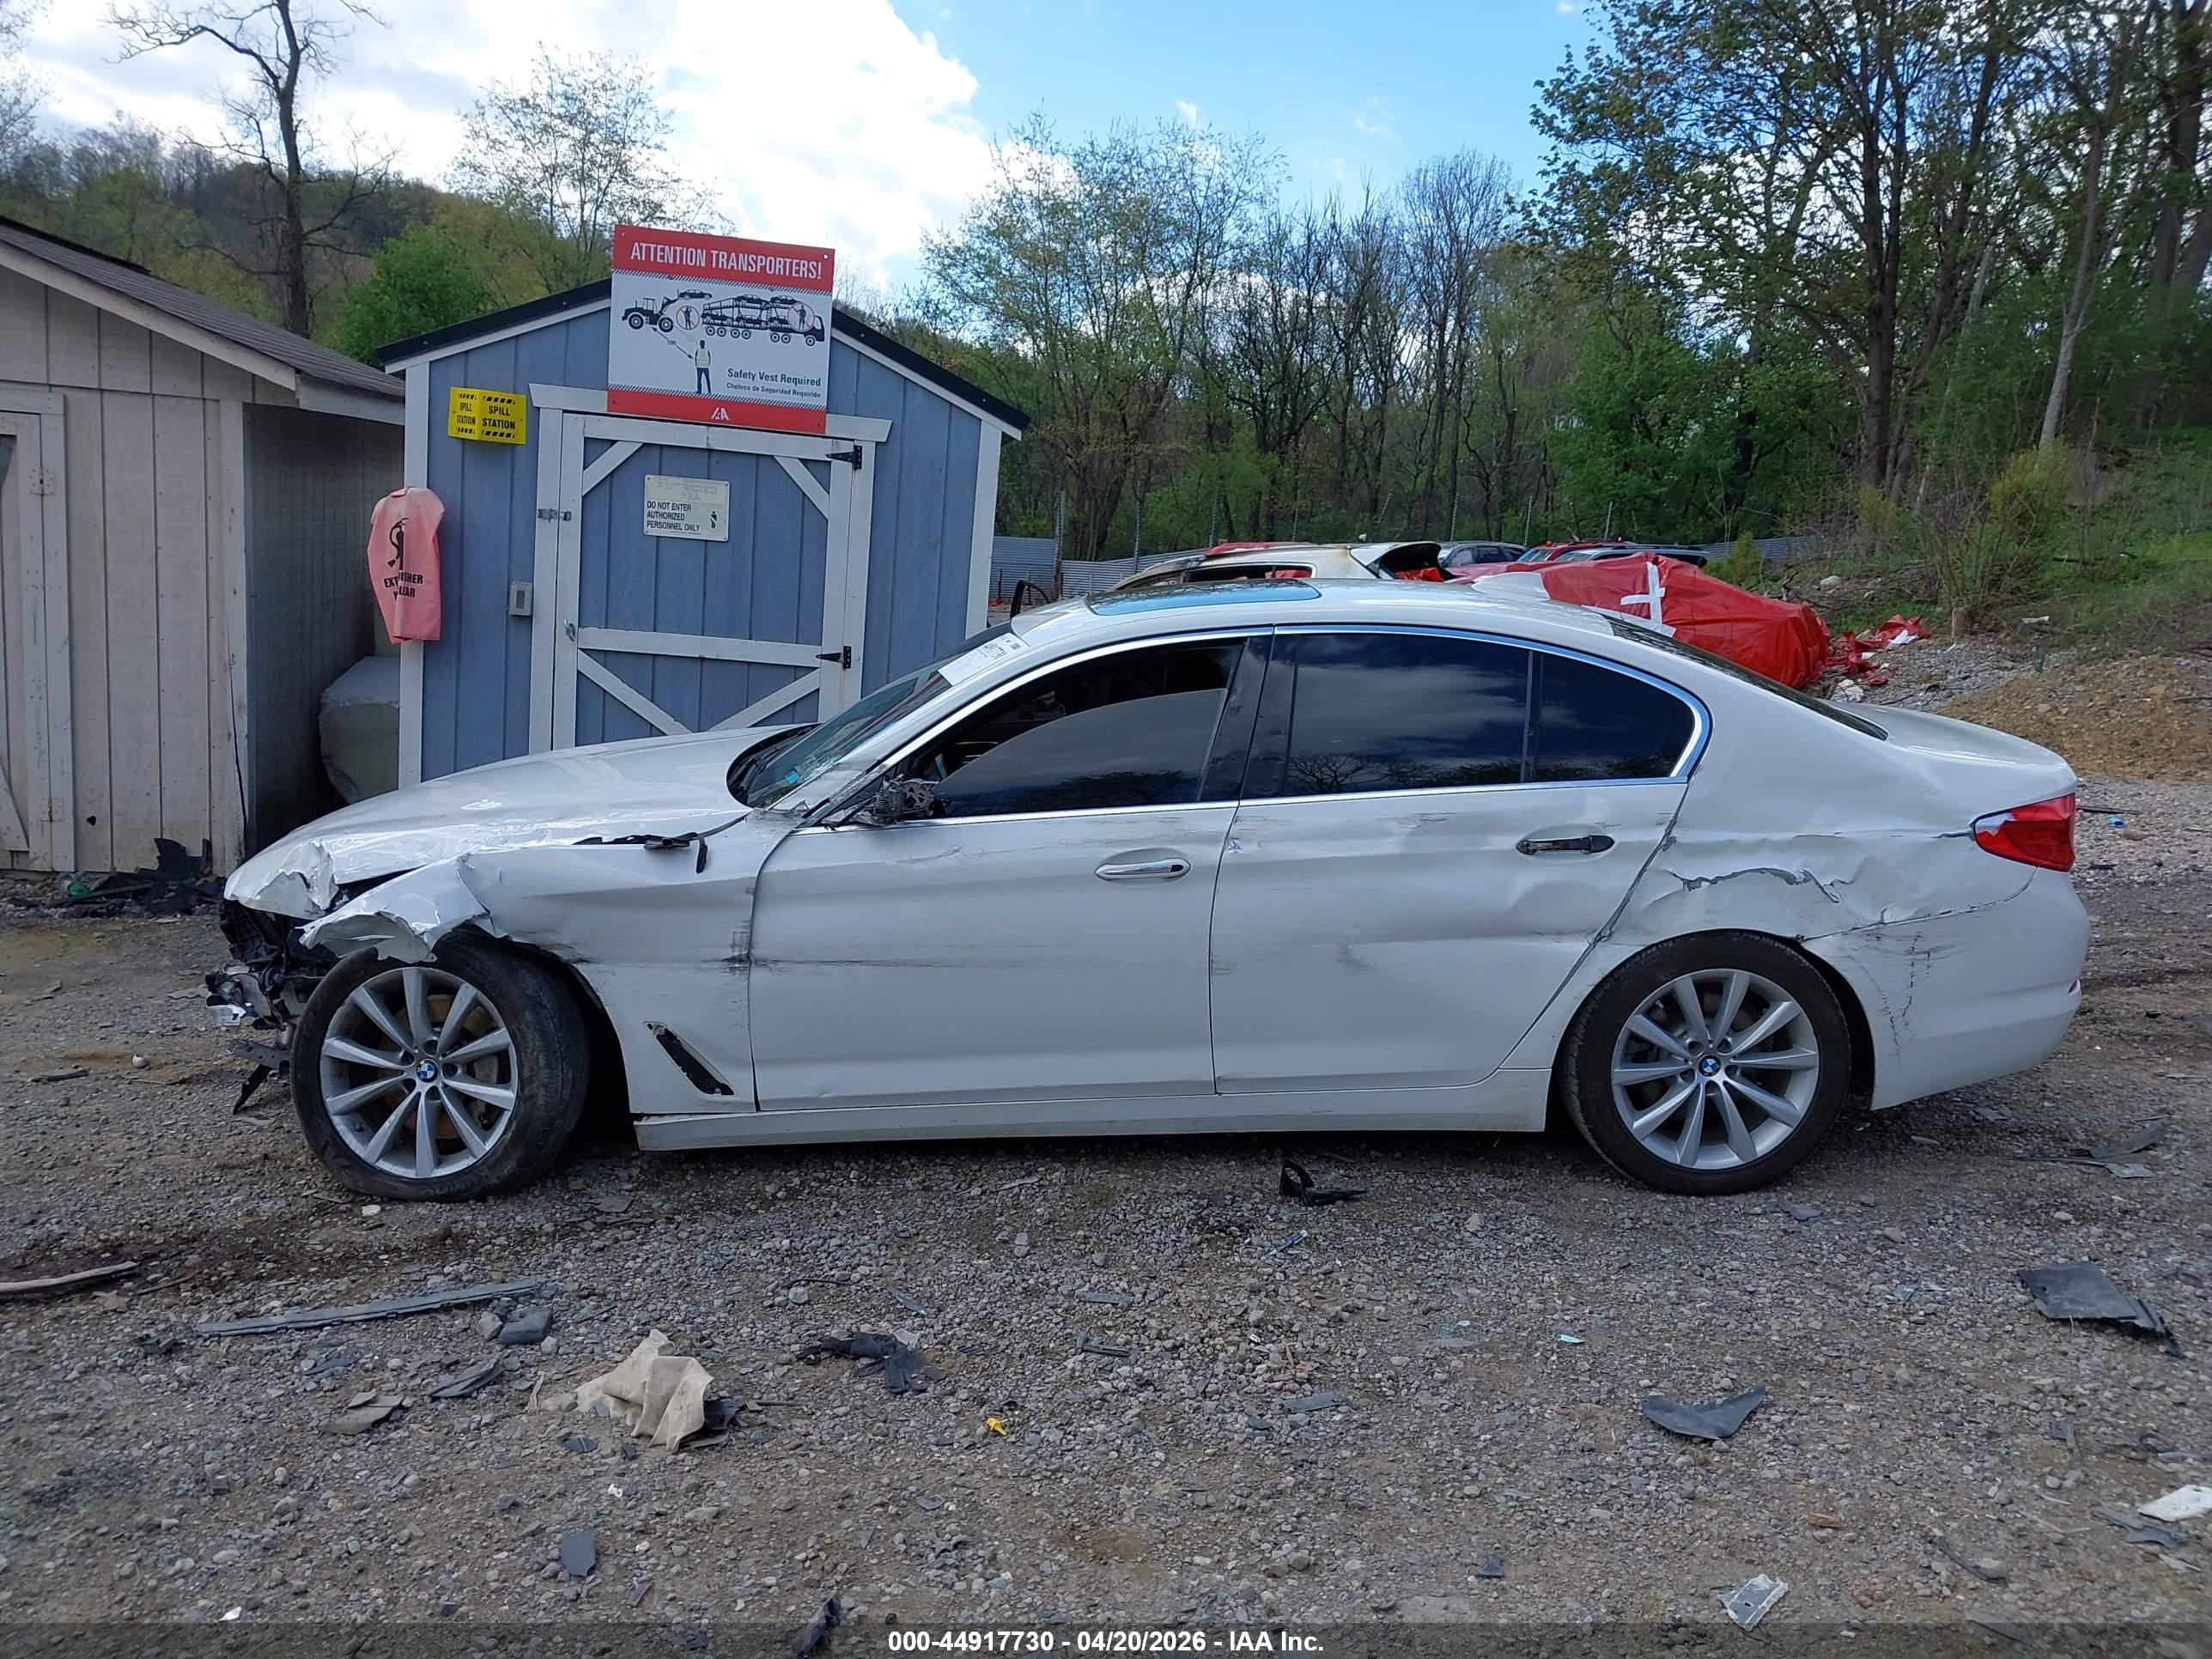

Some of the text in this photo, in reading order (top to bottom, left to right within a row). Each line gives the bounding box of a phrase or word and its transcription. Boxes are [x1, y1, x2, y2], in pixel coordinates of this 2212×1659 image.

[631, 241, 823, 280] ATTENTION TRANSPORTERS!
[727, 368, 822, 387] Safety Vest Required
[761, 386, 791, 395] Seguridad
[459, 402, 473, 412] SPILL
[489, 404, 510, 416] SPILL
[456, 415, 476, 426] STATION
[482, 417, 516, 430] STATION
[647, 501, 692, 512] DO NOT ENTER
[647, 510, 685, 521] AUTHORIZED
[647, 520, 701, 532] PERSONNEL ONLY
